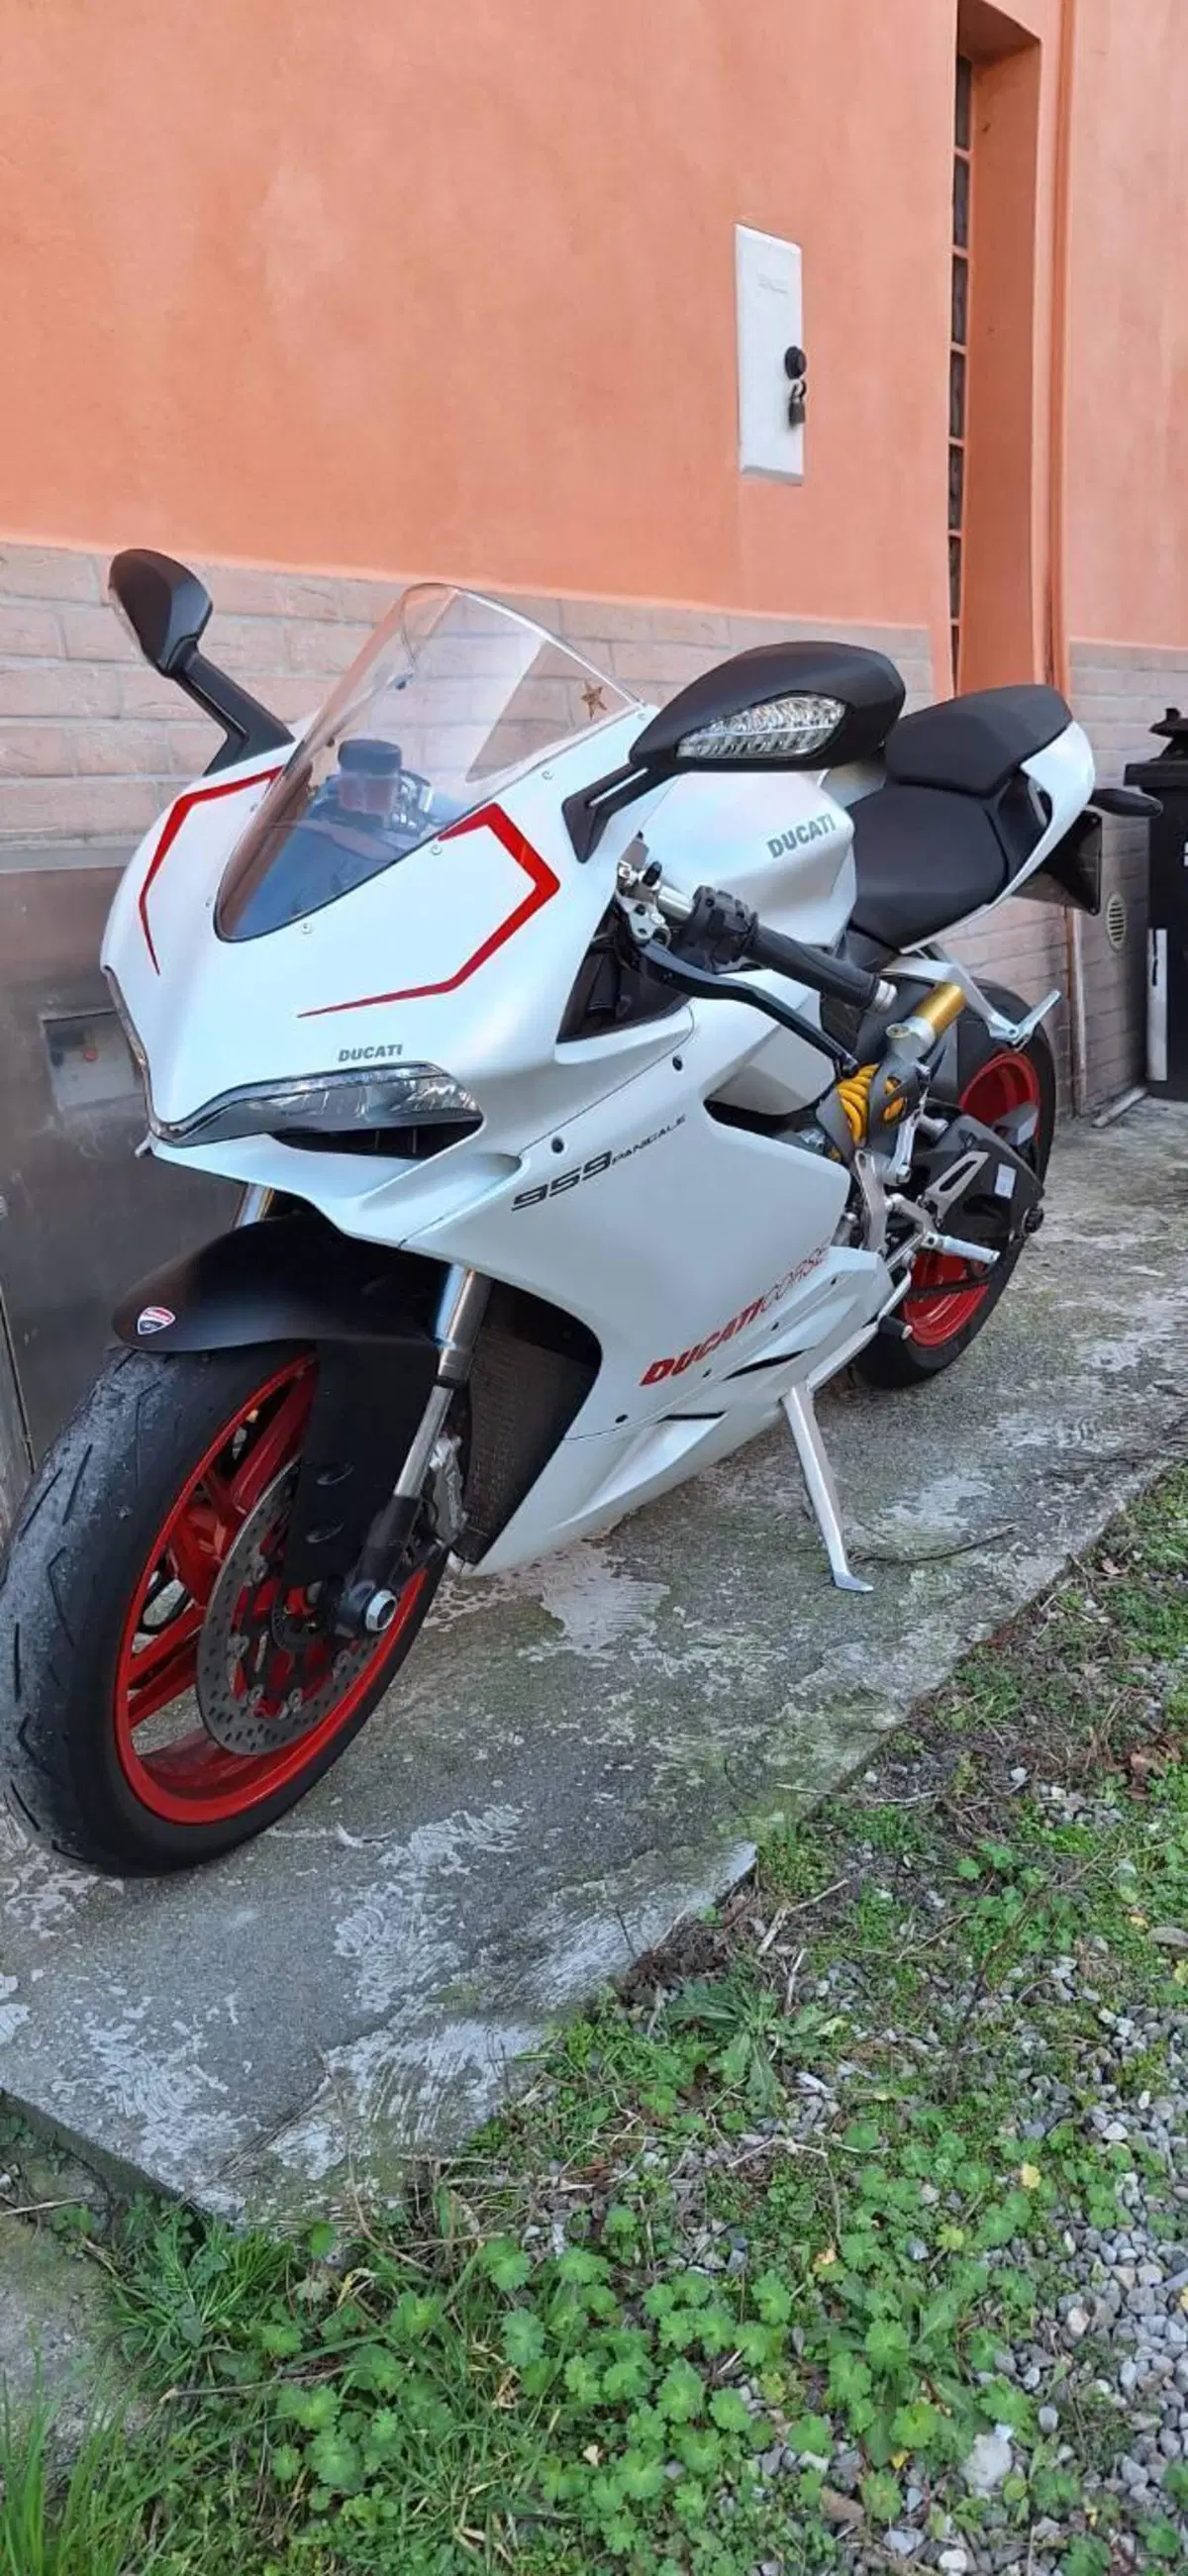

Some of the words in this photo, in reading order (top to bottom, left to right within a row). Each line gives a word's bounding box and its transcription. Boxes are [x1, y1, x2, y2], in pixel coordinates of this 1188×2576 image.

[766, 813, 837, 858] DUCATI
[338, 1043, 403, 1062] DUCATI
[511, 1150, 612, 1212] 959
[640, 1296, 765, 1387] DUCATI
